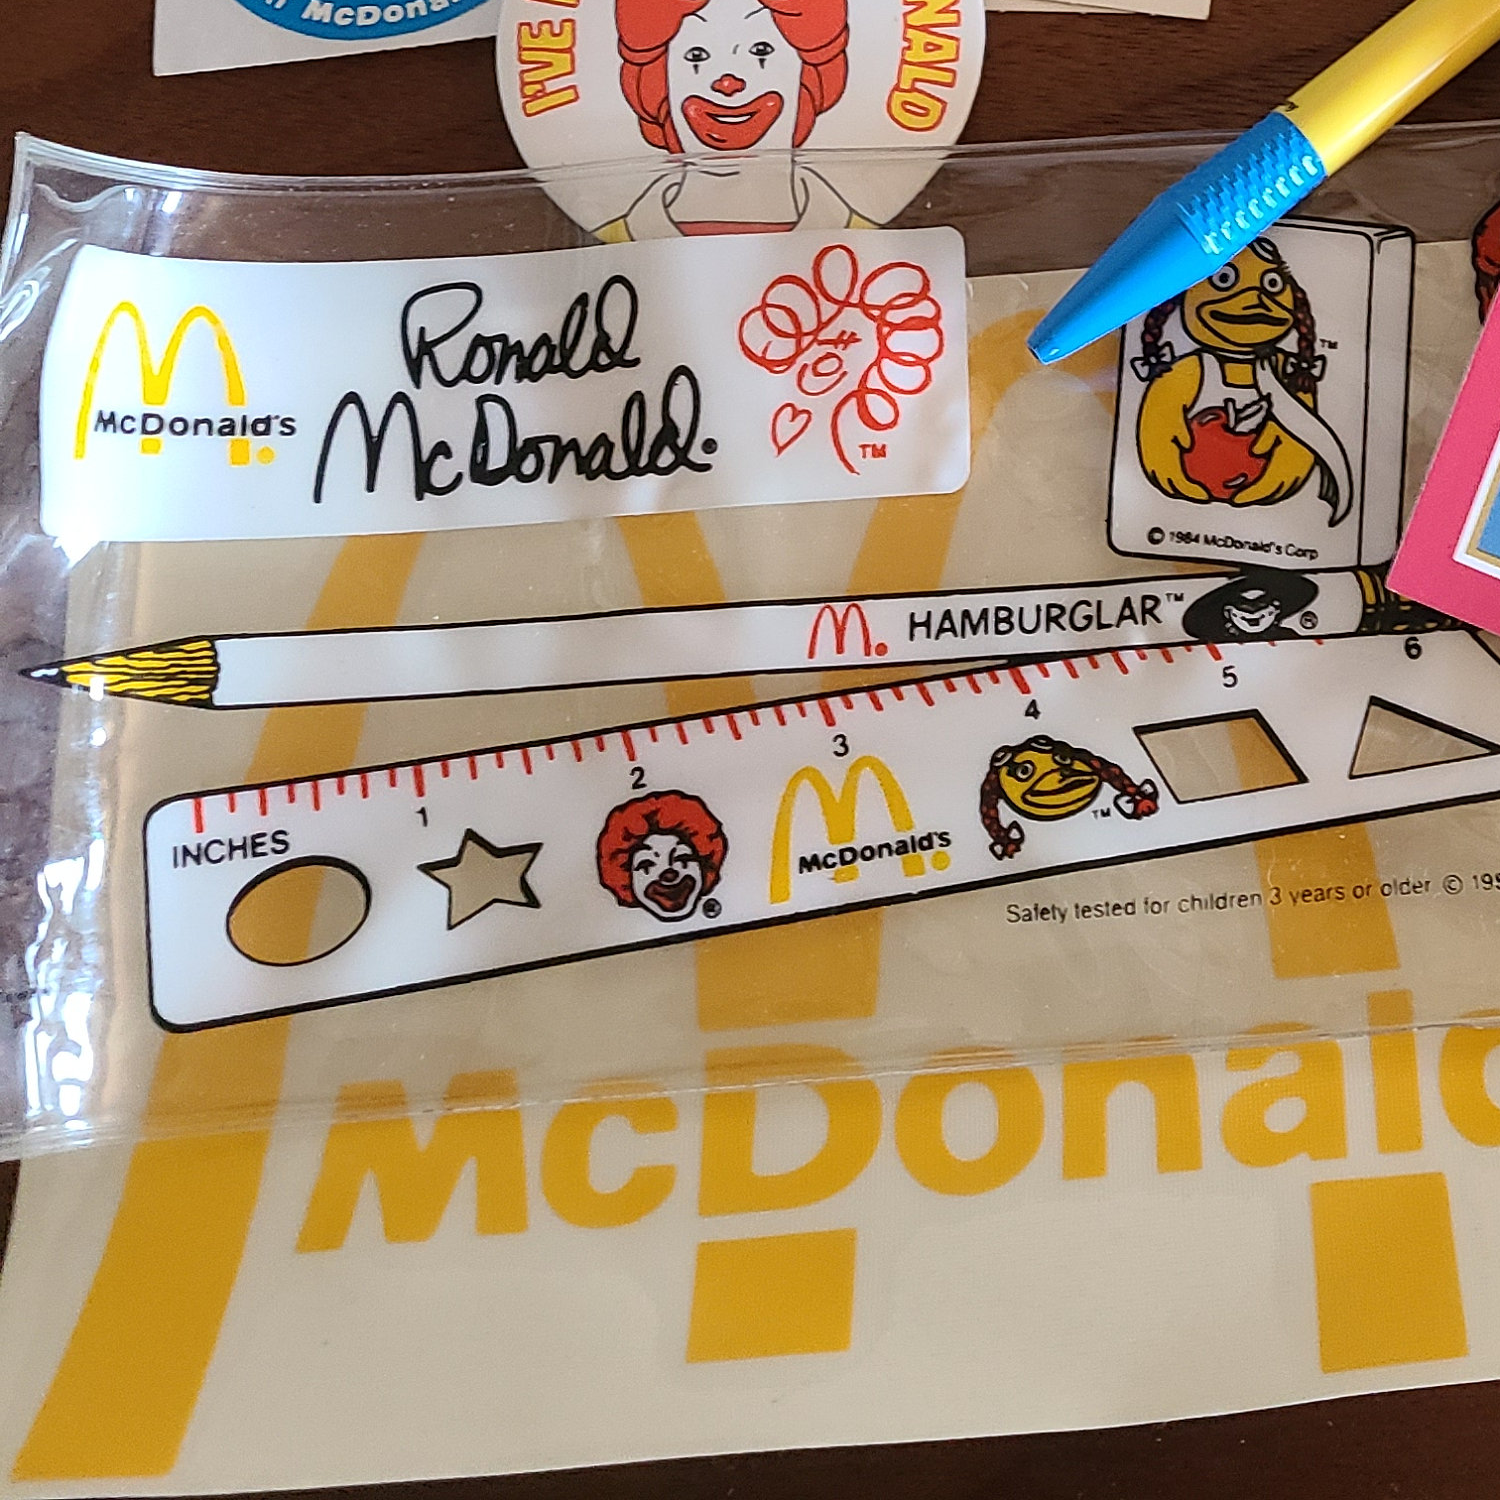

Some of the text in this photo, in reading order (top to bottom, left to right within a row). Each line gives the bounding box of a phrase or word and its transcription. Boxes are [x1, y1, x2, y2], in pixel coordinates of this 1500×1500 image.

[516, 18, 580, 118] I'VE
[400, 274, 640, 389] Ronald
[93, 411, 298, 439] McDonald's
[1169, 529, 1202, 546] 1984
[1203, 533, 1284, 556] McDonald's
[1285, 543, 1319, 562] Corp
[417, 637, 1422, 828] 1 2 3 4 5 6
[171, 828, 291, 869] INCHES
[797, 831, 953, 875] McDonald's
[1006, 903, 1069, 925] Safety
[1073, 899, 1137, 920] tested
[1143, 897, 1171, 915] for
[1177, 890, 1263, 915] children
[1268, 886, 1282, 904] 3
[1288, 880, 1346, 908] years
[1352, 880, 1373, 900] or
[1380, 876, 1432, 897] older
